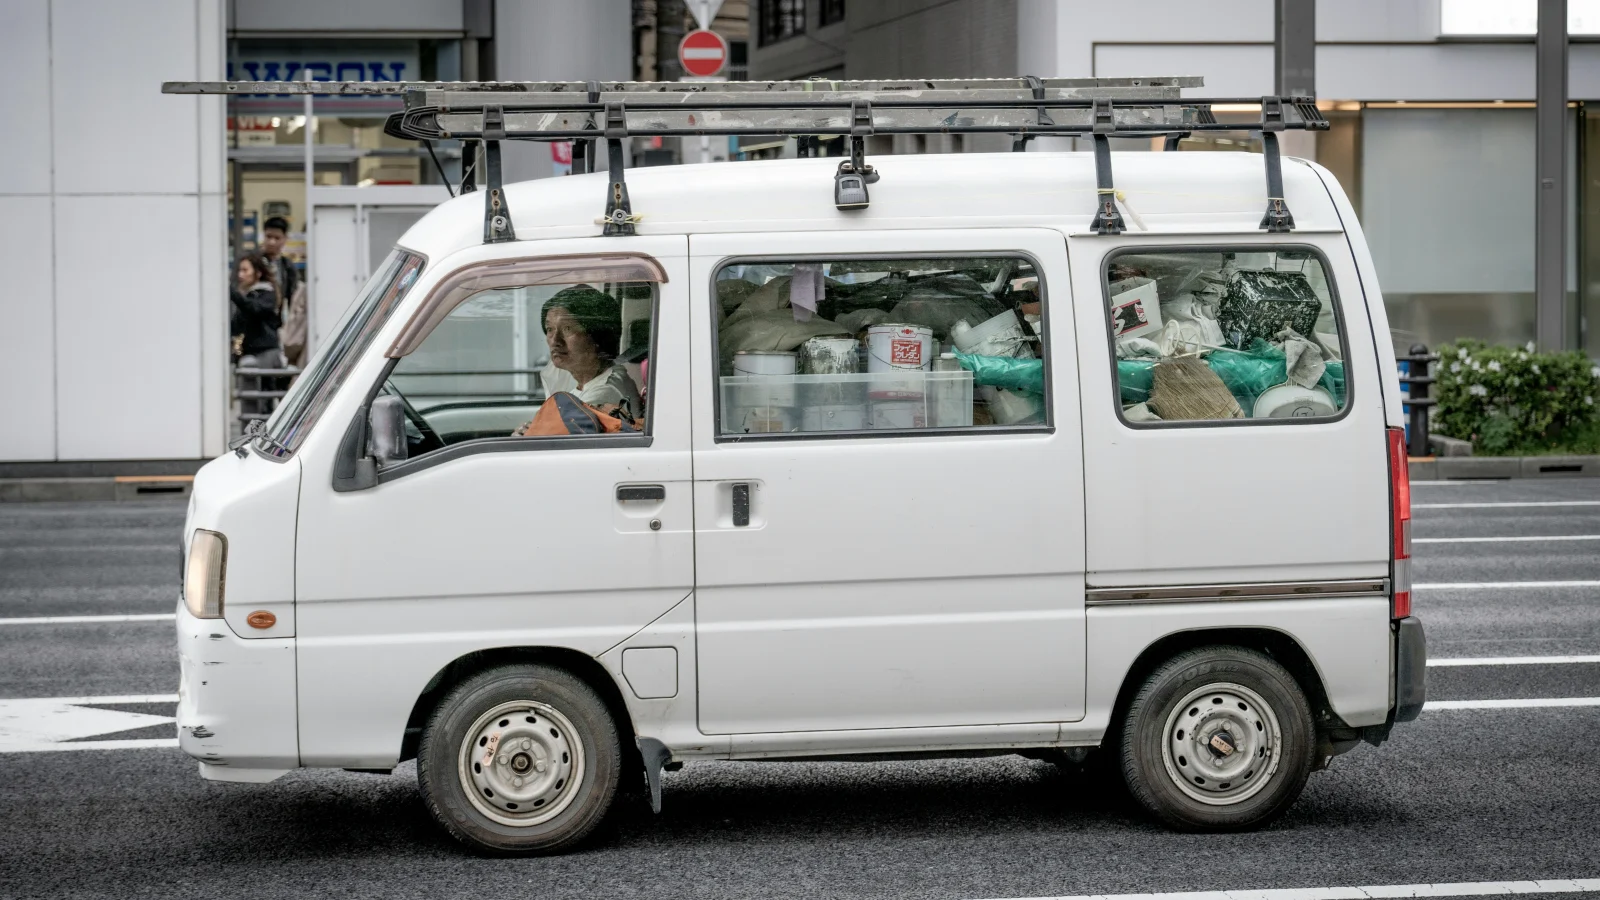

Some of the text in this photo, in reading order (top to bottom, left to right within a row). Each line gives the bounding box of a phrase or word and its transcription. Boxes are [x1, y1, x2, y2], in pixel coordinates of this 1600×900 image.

[227, 61, 406, 98] WSON
[893, 343, 917, 352] ファイン
[896, 351, 920, 359] ウレタン
